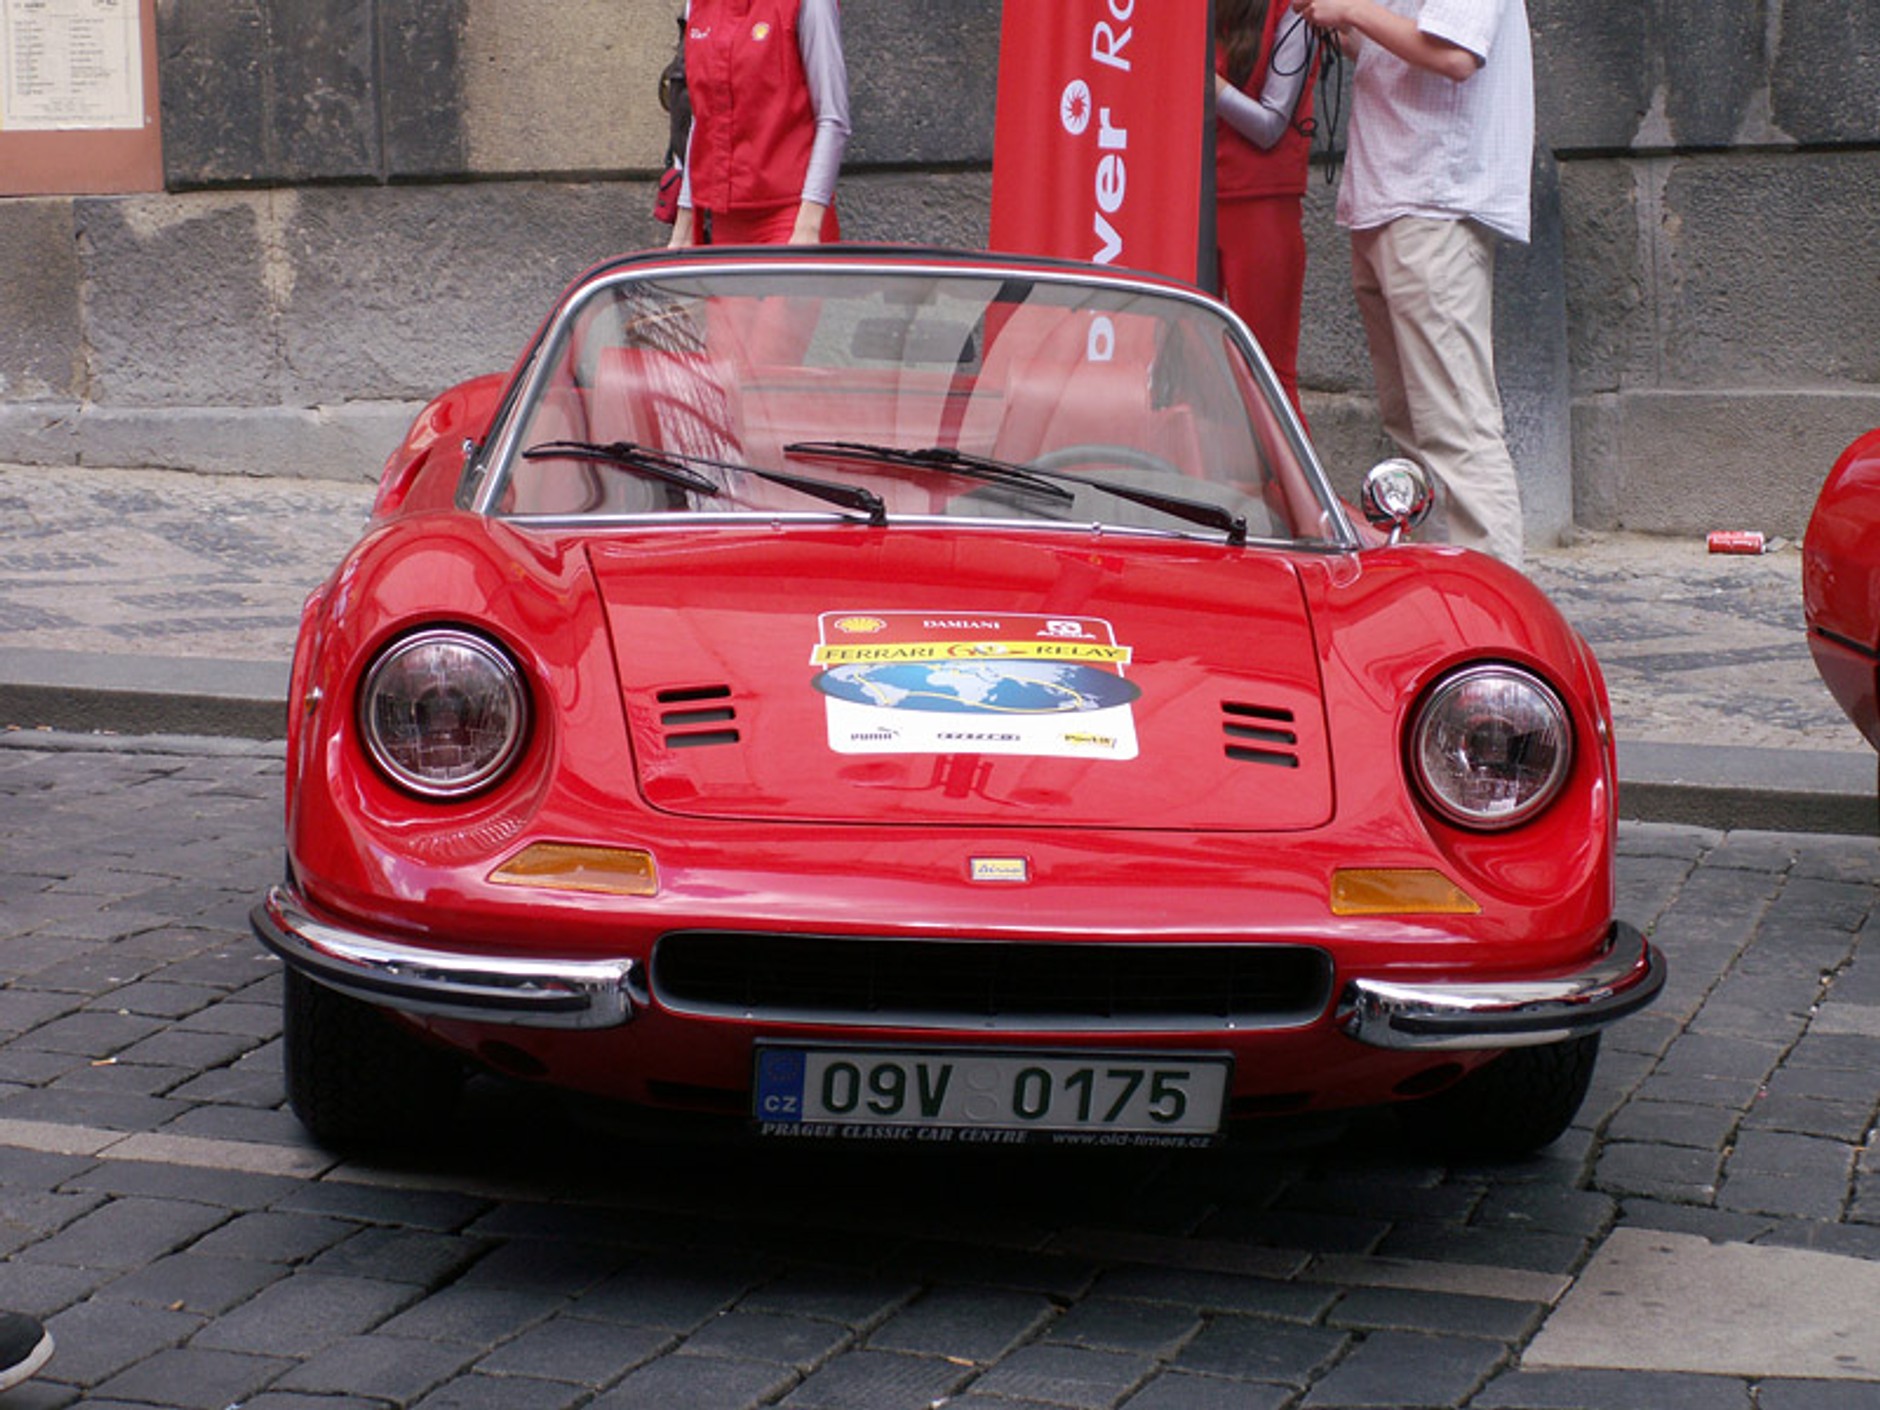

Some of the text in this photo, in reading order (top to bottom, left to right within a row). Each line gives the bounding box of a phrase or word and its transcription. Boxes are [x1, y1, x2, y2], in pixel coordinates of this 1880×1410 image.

[922, 620, 1000, 629] DAMIANI
[825, 646, 1117, 659] FERRARI RELAY
[821, 1061, 1191, 1123] 09V 0175
[764, 1095, 797, 1112] CZ
[761, 1122, 838, 1137] PRAGUE
[841, 1125, 914, 1140] CLASSIC
[917, 1127, 953, 1141] CAR
[958, 1129, 1028, 1143] CENTRE
